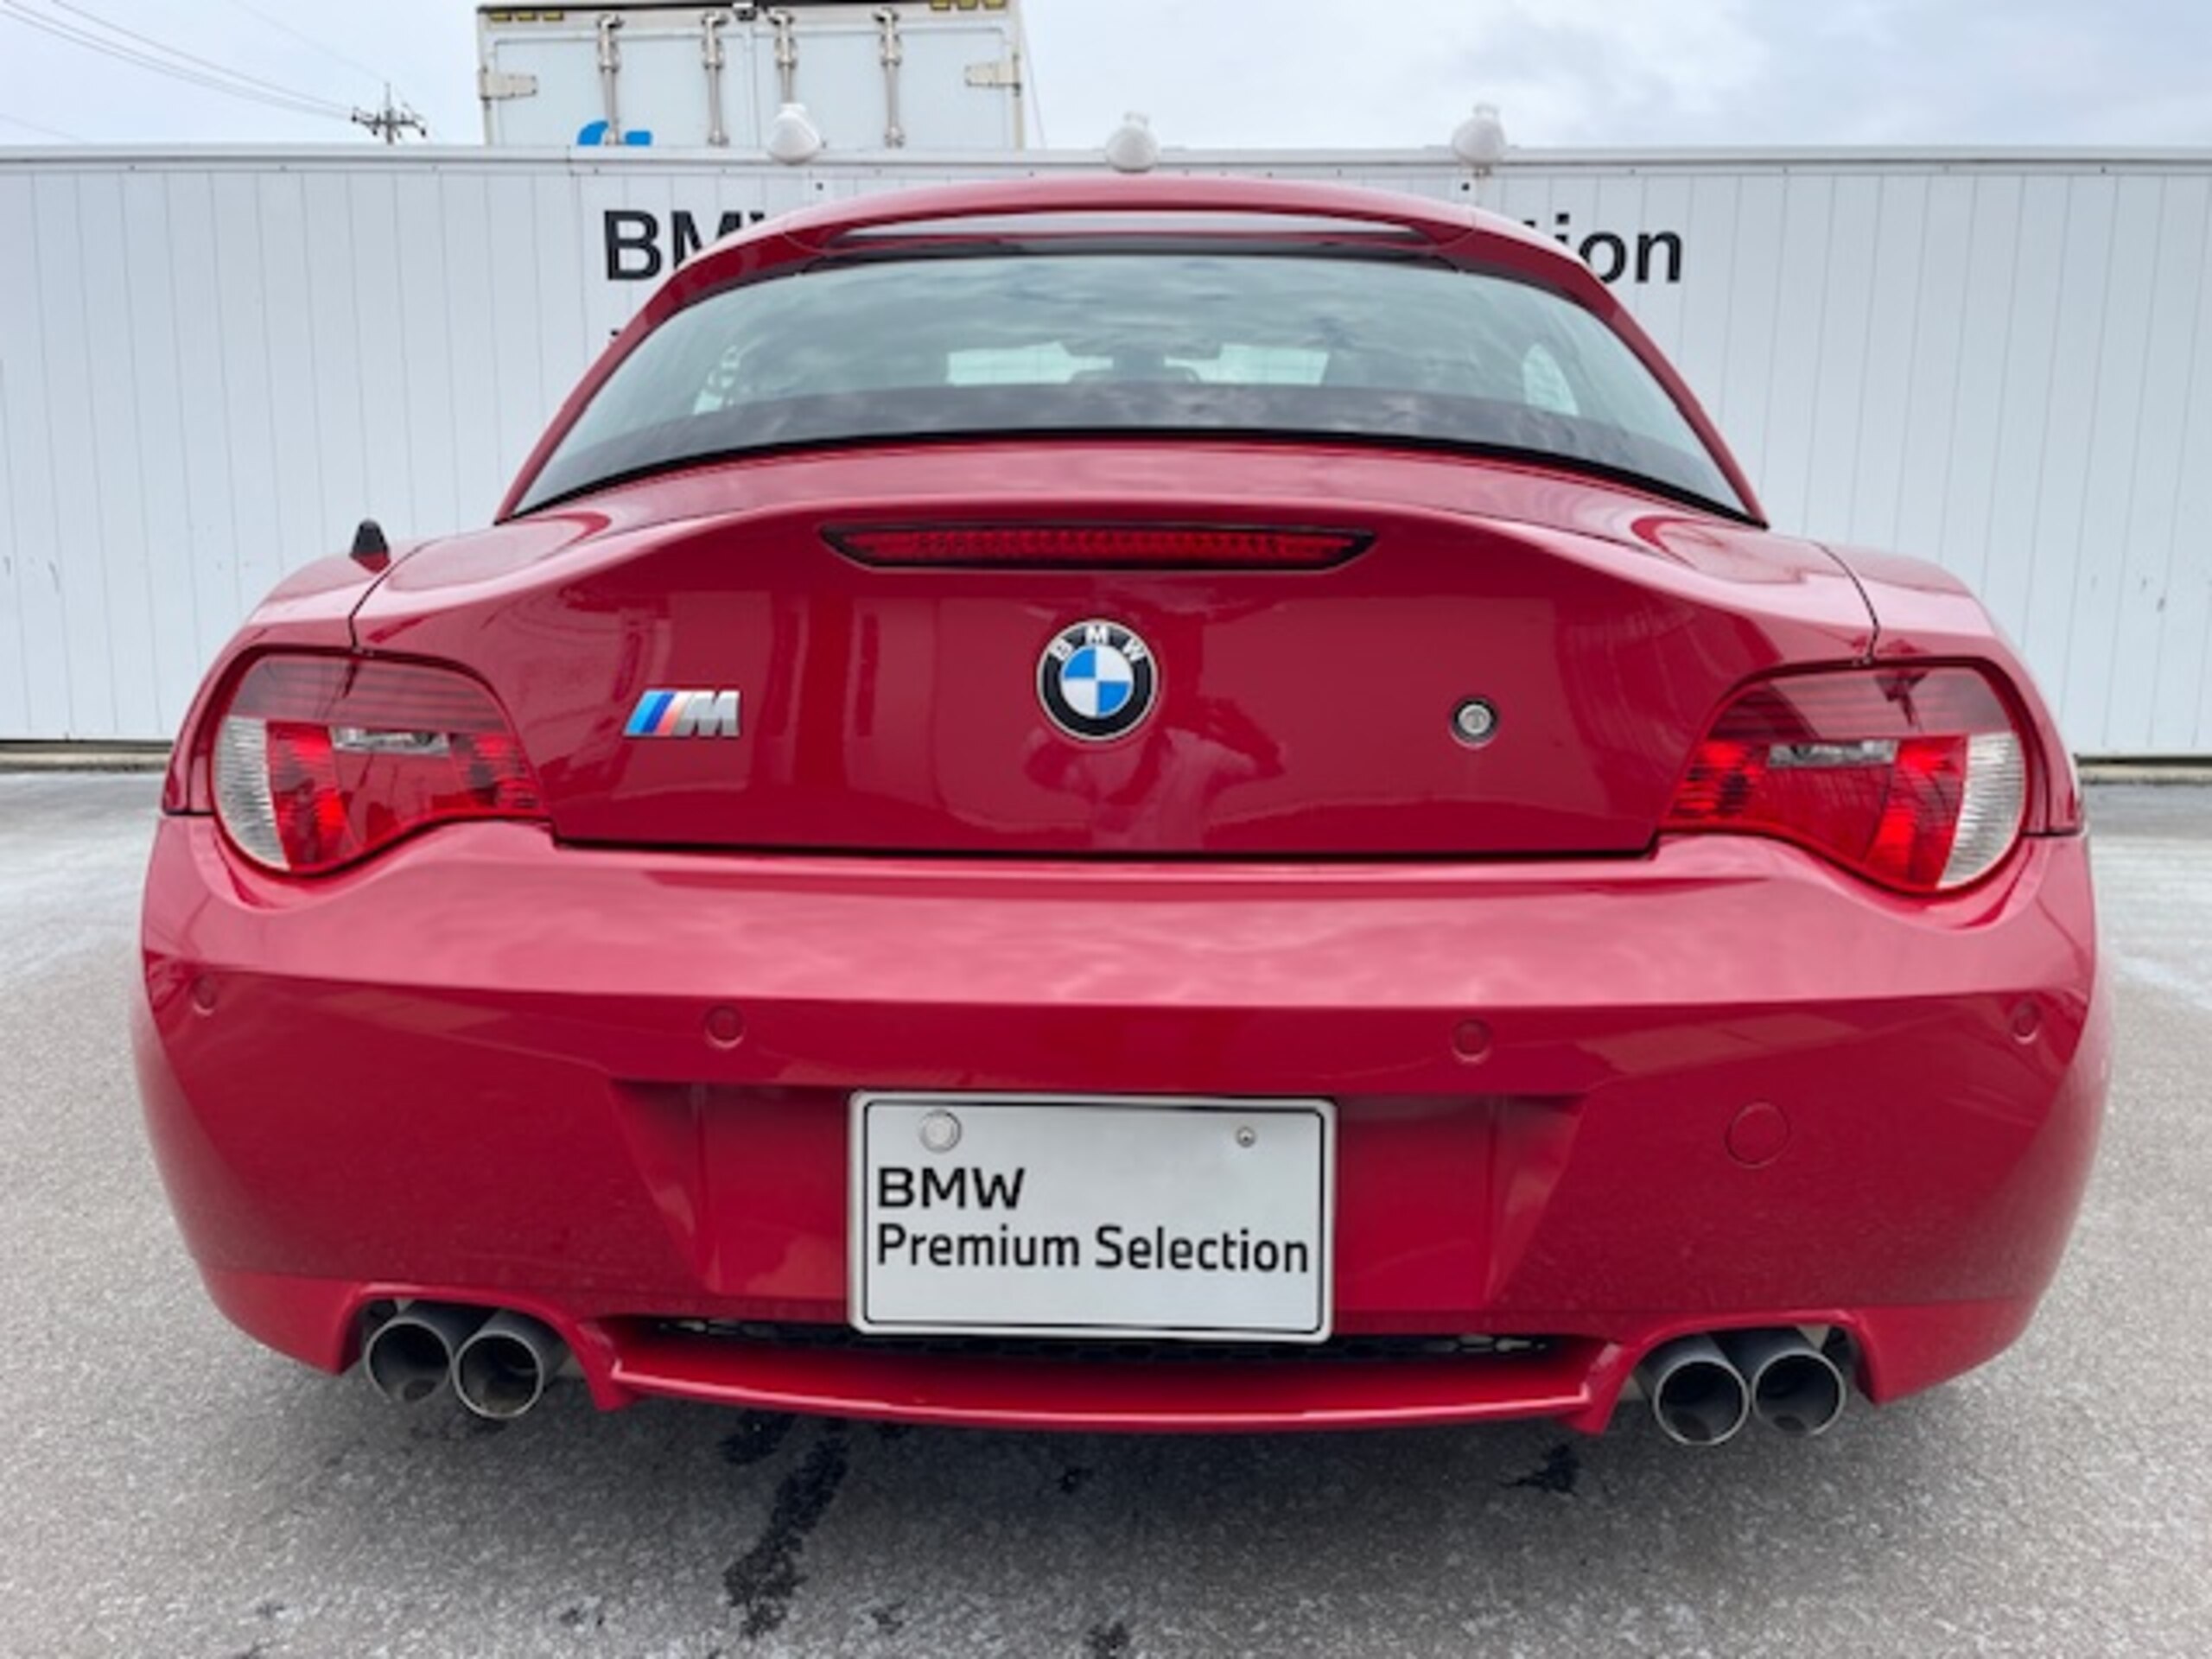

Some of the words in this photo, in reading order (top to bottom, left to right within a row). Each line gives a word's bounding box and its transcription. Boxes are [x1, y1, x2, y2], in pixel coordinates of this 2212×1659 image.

[605, 211, 765, 280] BM
[1047, 625, 1147, 663] BMW
[877, 1166, 1026, 1209] BMW
[877, 1223, 1080, 1268] Premium
[1094, 1225, 1309, 1273] Selection
